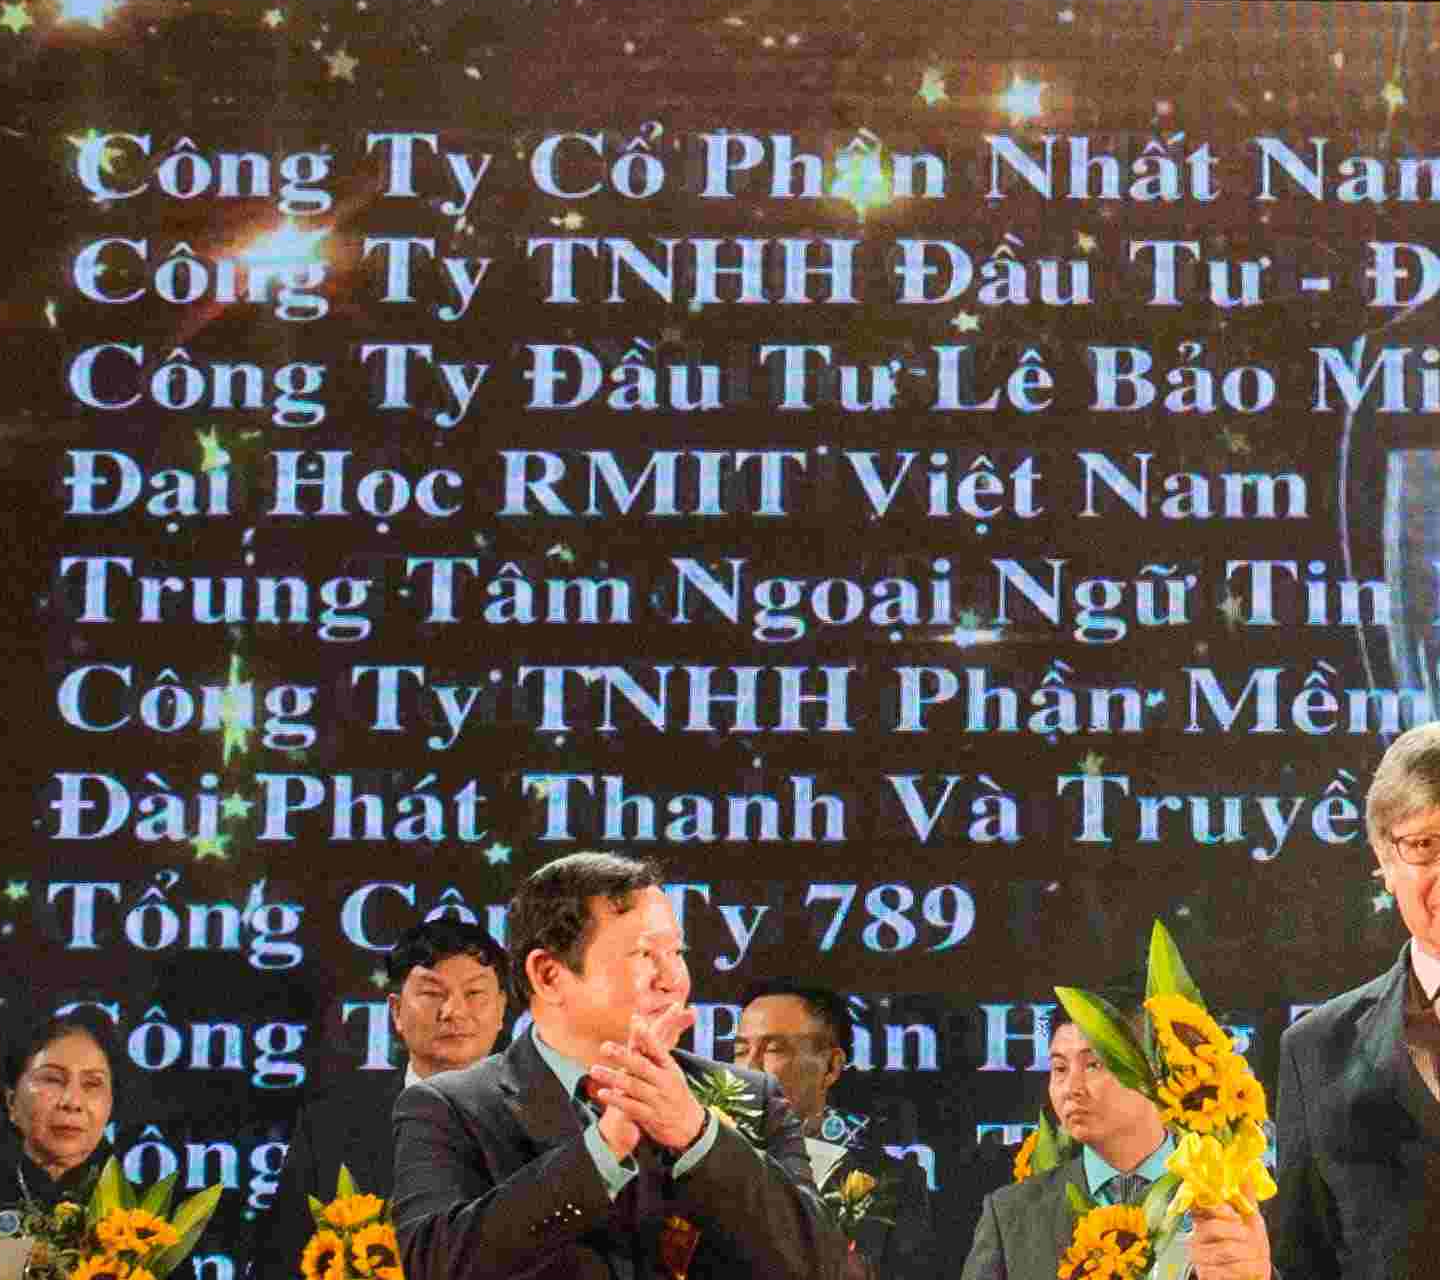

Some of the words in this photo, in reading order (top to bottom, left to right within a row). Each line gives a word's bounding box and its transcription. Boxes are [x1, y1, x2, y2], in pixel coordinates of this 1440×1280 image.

[73, 128, 333, 215] Công
[366, 132, 492, 215] Ty
[530, 120, 664, 199] Cổ
[698, 127, 945, 199] Phần
[984, 130, 1220, 203] Nhất
[73, 238, 330, 321] Công
[362, 237, 490, 321] Ty
[527, 237, 860, 305] TNHH
[894, 230, 1095, 307] Đầu
[1130, 239, 1272, 307] Tư
[1301, 280, 1332, 292] -
[68, 338, 325, 426] Công
[360, 342, 487, 426] Ty
[523, 337, 720, 410] Đầu
[760, 344, 902, 410] Tư
[930, 345, 1054, 411] Lê
[1088, 342, 1276, 413] Bảo
[63, 448, 230, 530] Đại
[267, 450, 462, 532] Học
[497, 450, 805, 516] RMIT
[845, 450, 1042, 534] Việt
[1077, 452, 1308, 518] Nam
[62, 556, 370, 642] Trung
[408, 553, 632, 625] Tâm
[672, 557, 952, 638] Ngoại
[996, 558, 1196, 643] Ngữ
[1225, 560, 1392, 625] Tin
[58, 663, 316, 748] Công
[352, 666, 485, 748] Ty
[520, 666, 850, 734] TNHH
[896, 660, 1142, 734] Phần
[1182, 658, 1430, 734] Mềm
[50, 773, 225, 845] Đài
[258, 772, 488, 842] Phát
[522, 775, 845, 843] Thanh
[890, 772, 1020, 843] Và
[1056, 770, 1360, 860] Truyề
[48, 870, 305, 970] Tổng
[803, 882, 976, 953] 789
[53, 1002, 307, 1088] ông
[108, 1123, 290, 1220] ông
